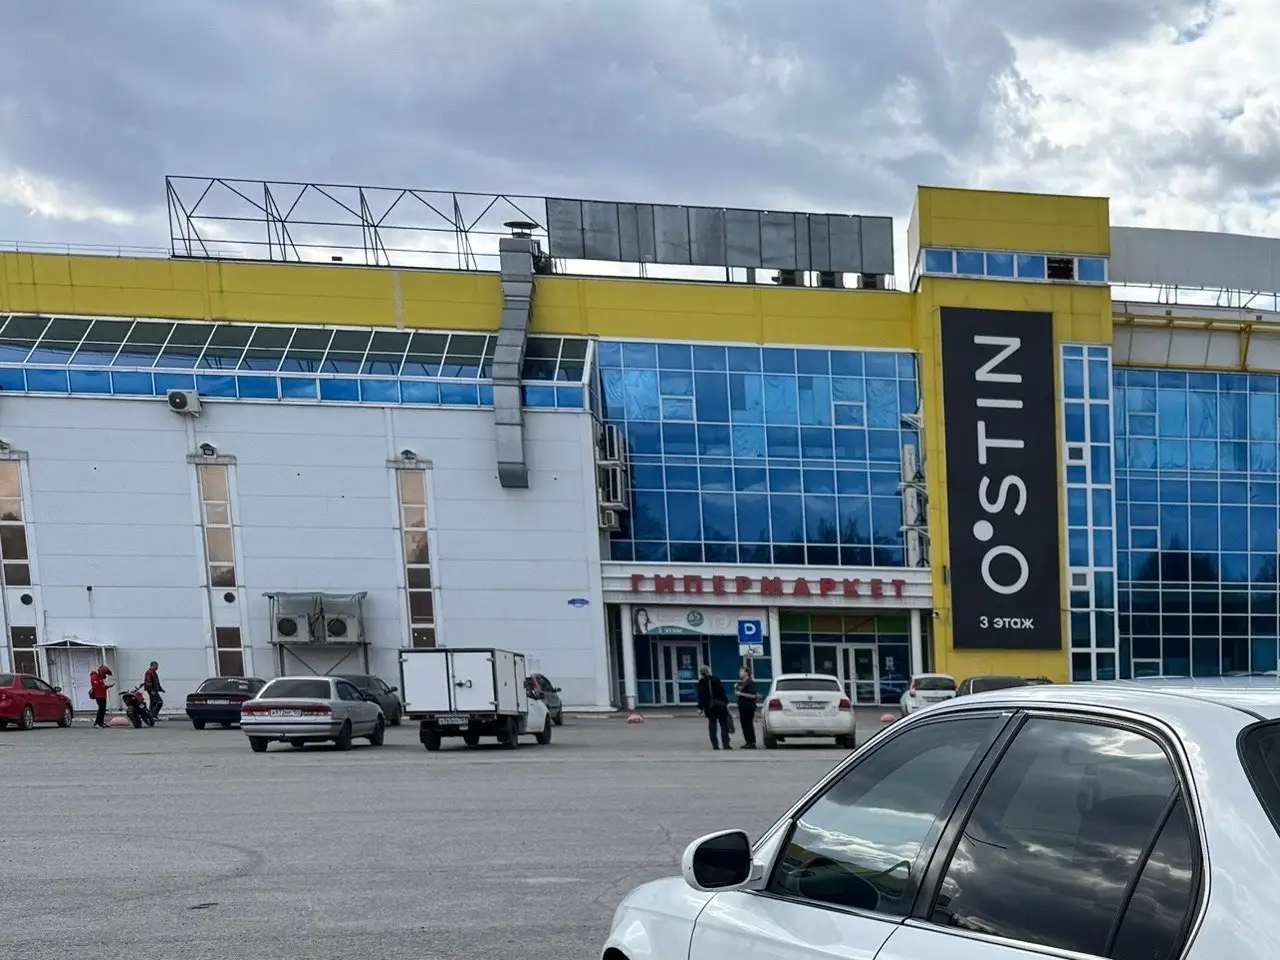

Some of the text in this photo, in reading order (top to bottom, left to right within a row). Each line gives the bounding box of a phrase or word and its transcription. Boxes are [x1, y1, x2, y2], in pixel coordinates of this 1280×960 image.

[632, 574, 906, 599] ГИПЕРМАРКЕТ
[980, 616, 1034, 629] 3 этаж
